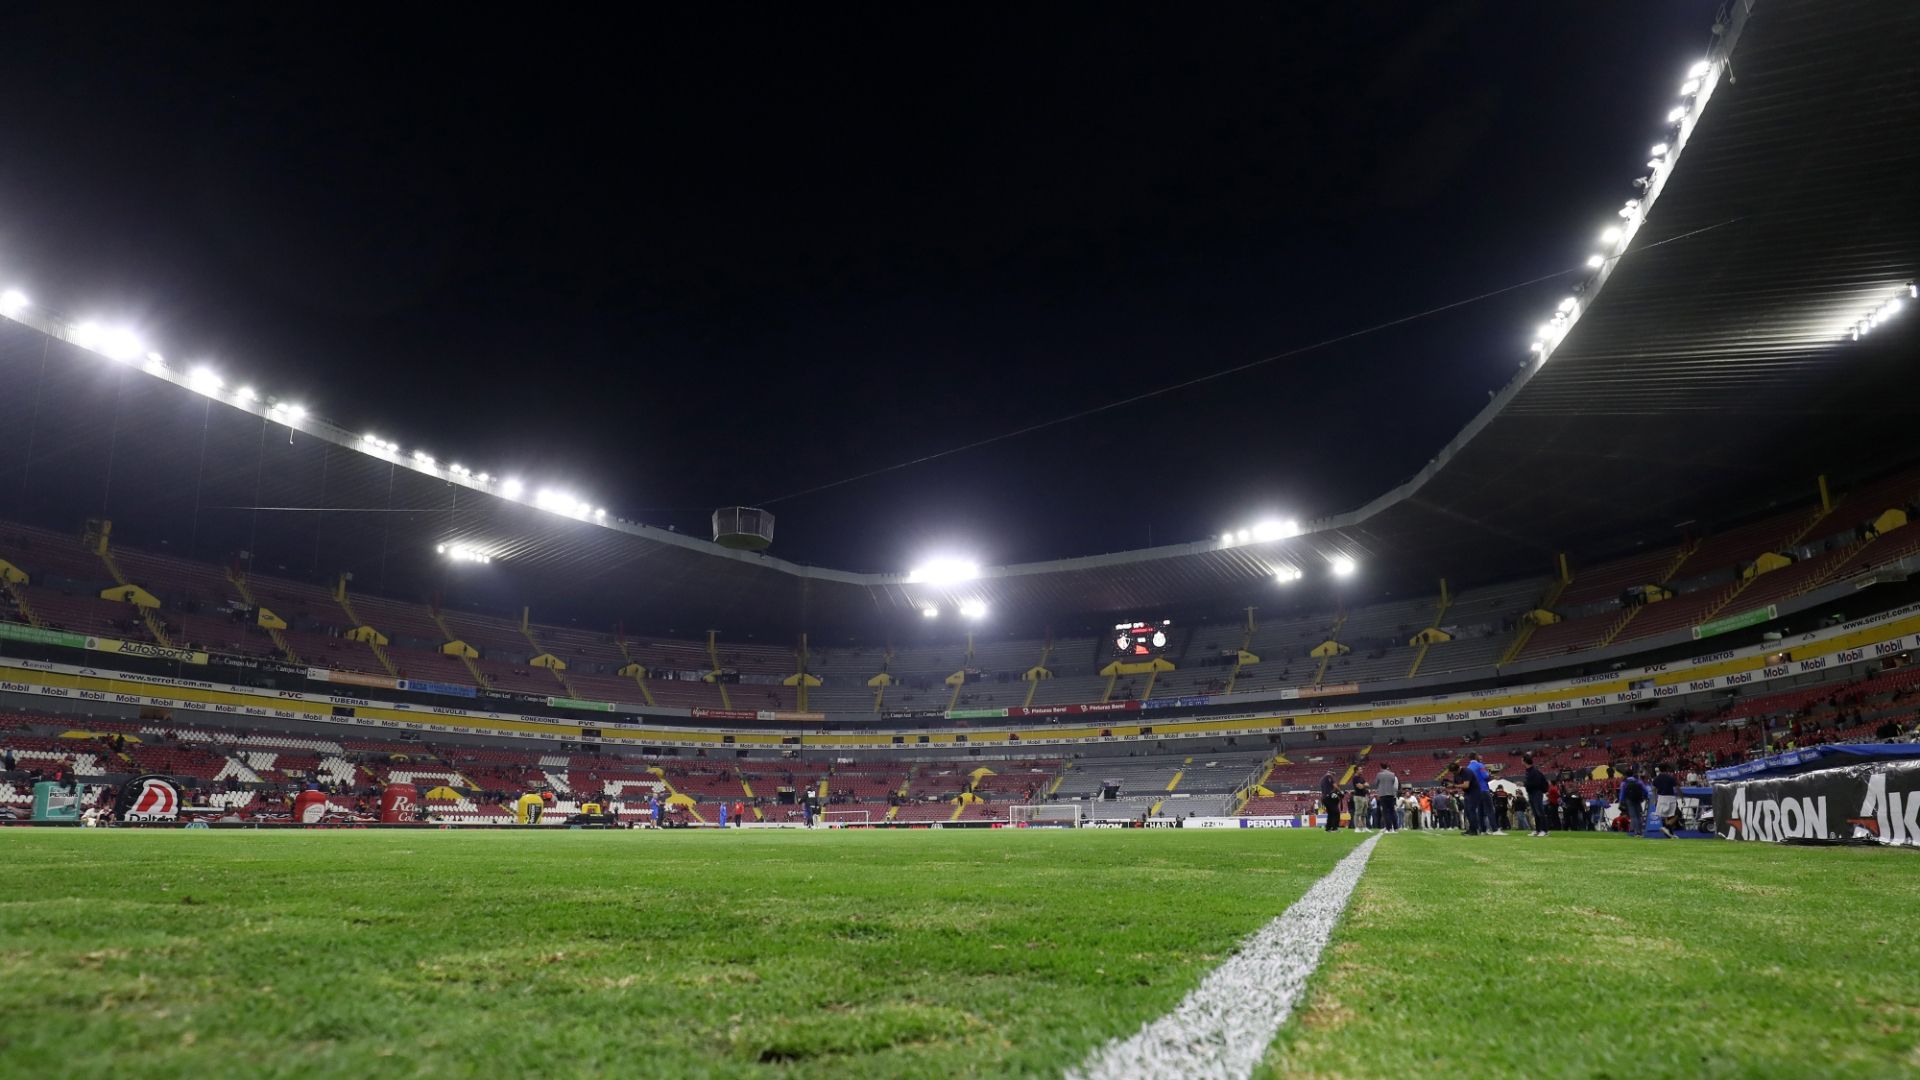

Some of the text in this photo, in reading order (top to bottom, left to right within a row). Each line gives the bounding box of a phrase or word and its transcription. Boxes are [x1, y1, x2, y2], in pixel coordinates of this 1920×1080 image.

[1876, 640, 1902, 654] Mobil
[1692, 650, 1734, 664] CEMENTOS
[1838, 650, 1863, 662] Mobil
[1644, 664, 1667, 673] PVC
[1801, 658, 1826, 671] Mobil
[1764, 666, 1789, 678] Mobil
[120, 672, 213, 688] www.serrot.com.mx
[1727, 673, 1751, 684] Mobil
[2, 682, 29, 692] Mobil
[1690, 680, 1714, 690] Mobil
[42, 687, 68, 696] Mobil
[80, 691, 104, 700] Mobil
[279, 691, 304, 699] PVC
[1618, 691, 1642, 701] Mobil
[1654, 686, 1678, 696] Mobil
[116, 694, 140, 703] Mobil
[1582, 696, 1606, 706] Mobil
[1514, 705, 1536, 714] Mobil
[1548, 701, 1571, 710] Mobil
[1414, 716, 1436, 724] Mobil
[1726, 788, 1828, 842] AKRON
